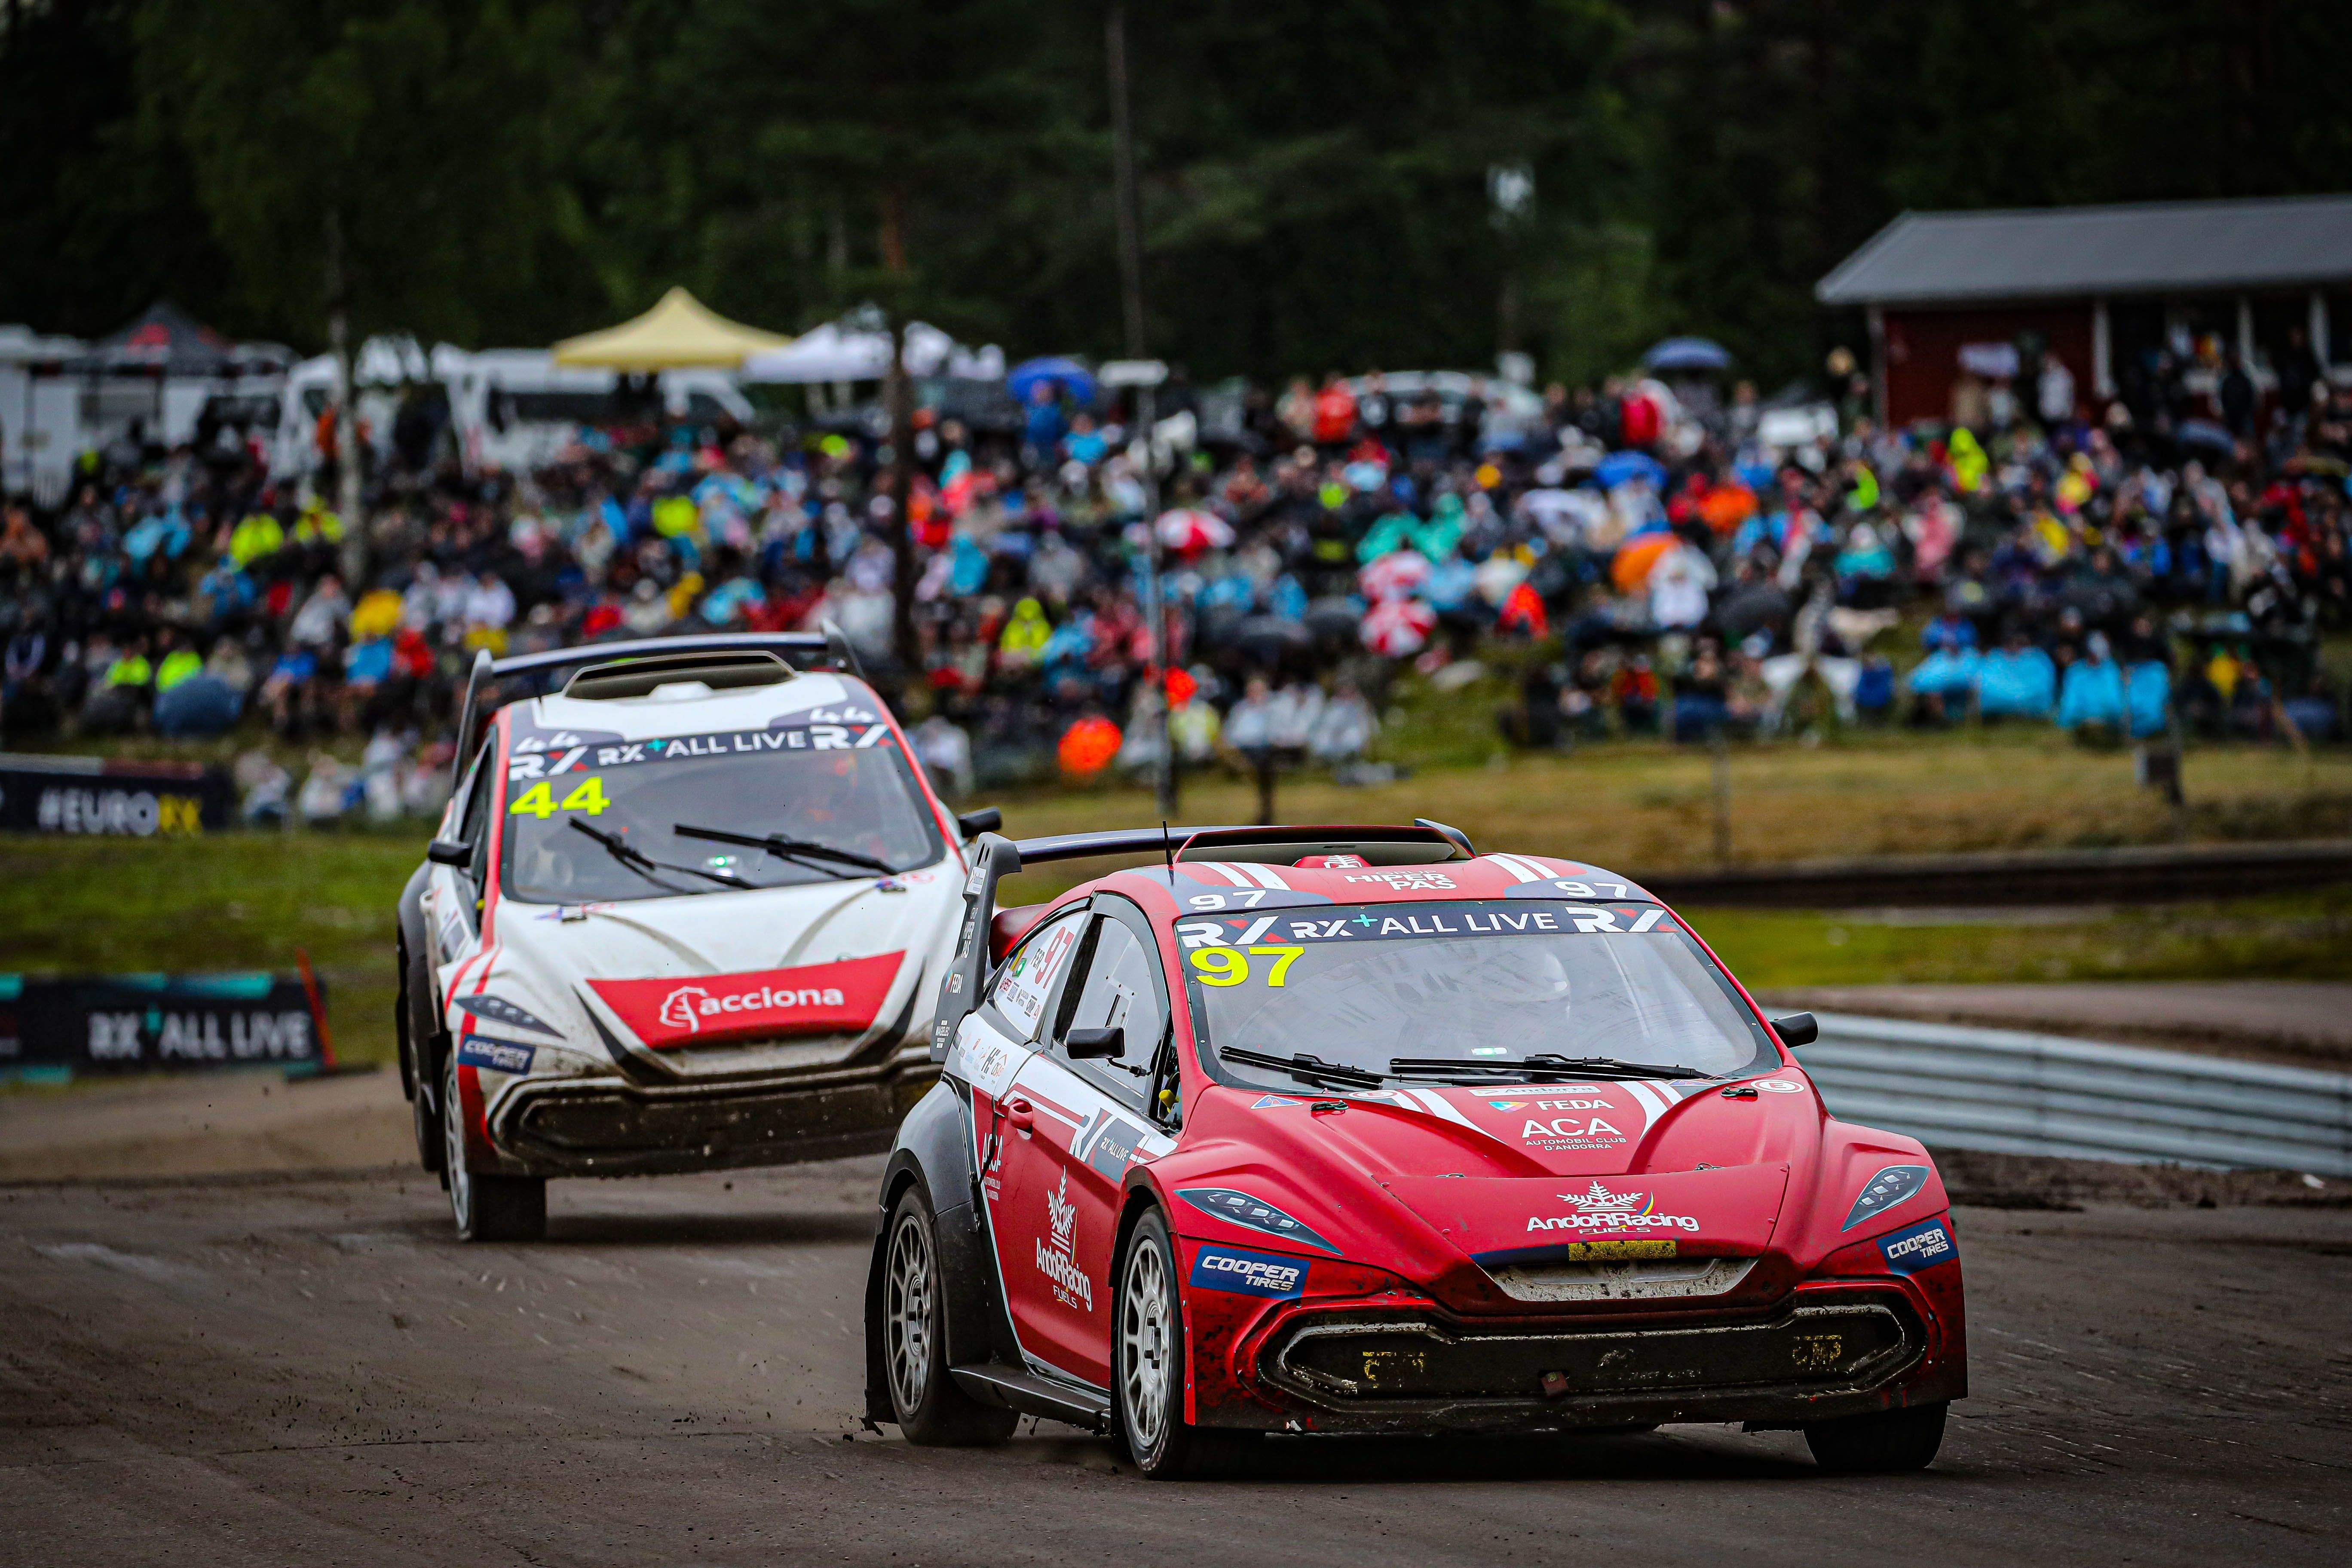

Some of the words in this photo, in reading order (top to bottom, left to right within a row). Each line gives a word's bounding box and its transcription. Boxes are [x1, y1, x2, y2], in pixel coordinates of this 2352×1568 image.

[733, 731, 807, 752] LIVE
[509, 776, 611, 819] 44
[1344, 873, 1450, 883] HIPER
[1389, 879, 1458, 891] PAS
[1553, 881, 1627, 898] 97
[1189, 890, 1266, 911] 97
[1464, 913, 1559, 932] LIVE
[1031, 948, 1045, 970] FER
[1035, 926, 1075, 989] 97
[1189, 946, 1305, 988] 97
[699, 986, 845, 1015] acciona
[231, 1009, 311, 1059] LIVE
[1535, 1099, 1615, 1111] FEDA
[1521, 1118, 1623, 1138] ACA
[1525, 1137, 1594, 1146] AUTOMÒBIL
[1116, 1145, 1130, 1162] LIVE
[1527, 1212, 1700, 1232] AndoRRacing
[1887, 1228, 1946, 1259] COOPER
[1919, 1240, 1949, 1259] TIRES
[1201, 1255, 1300, 1282] COOPER
[1245, 1274, 1295, 1292] TIRES
[1053, 1284, 1078, 1310] FUELS
